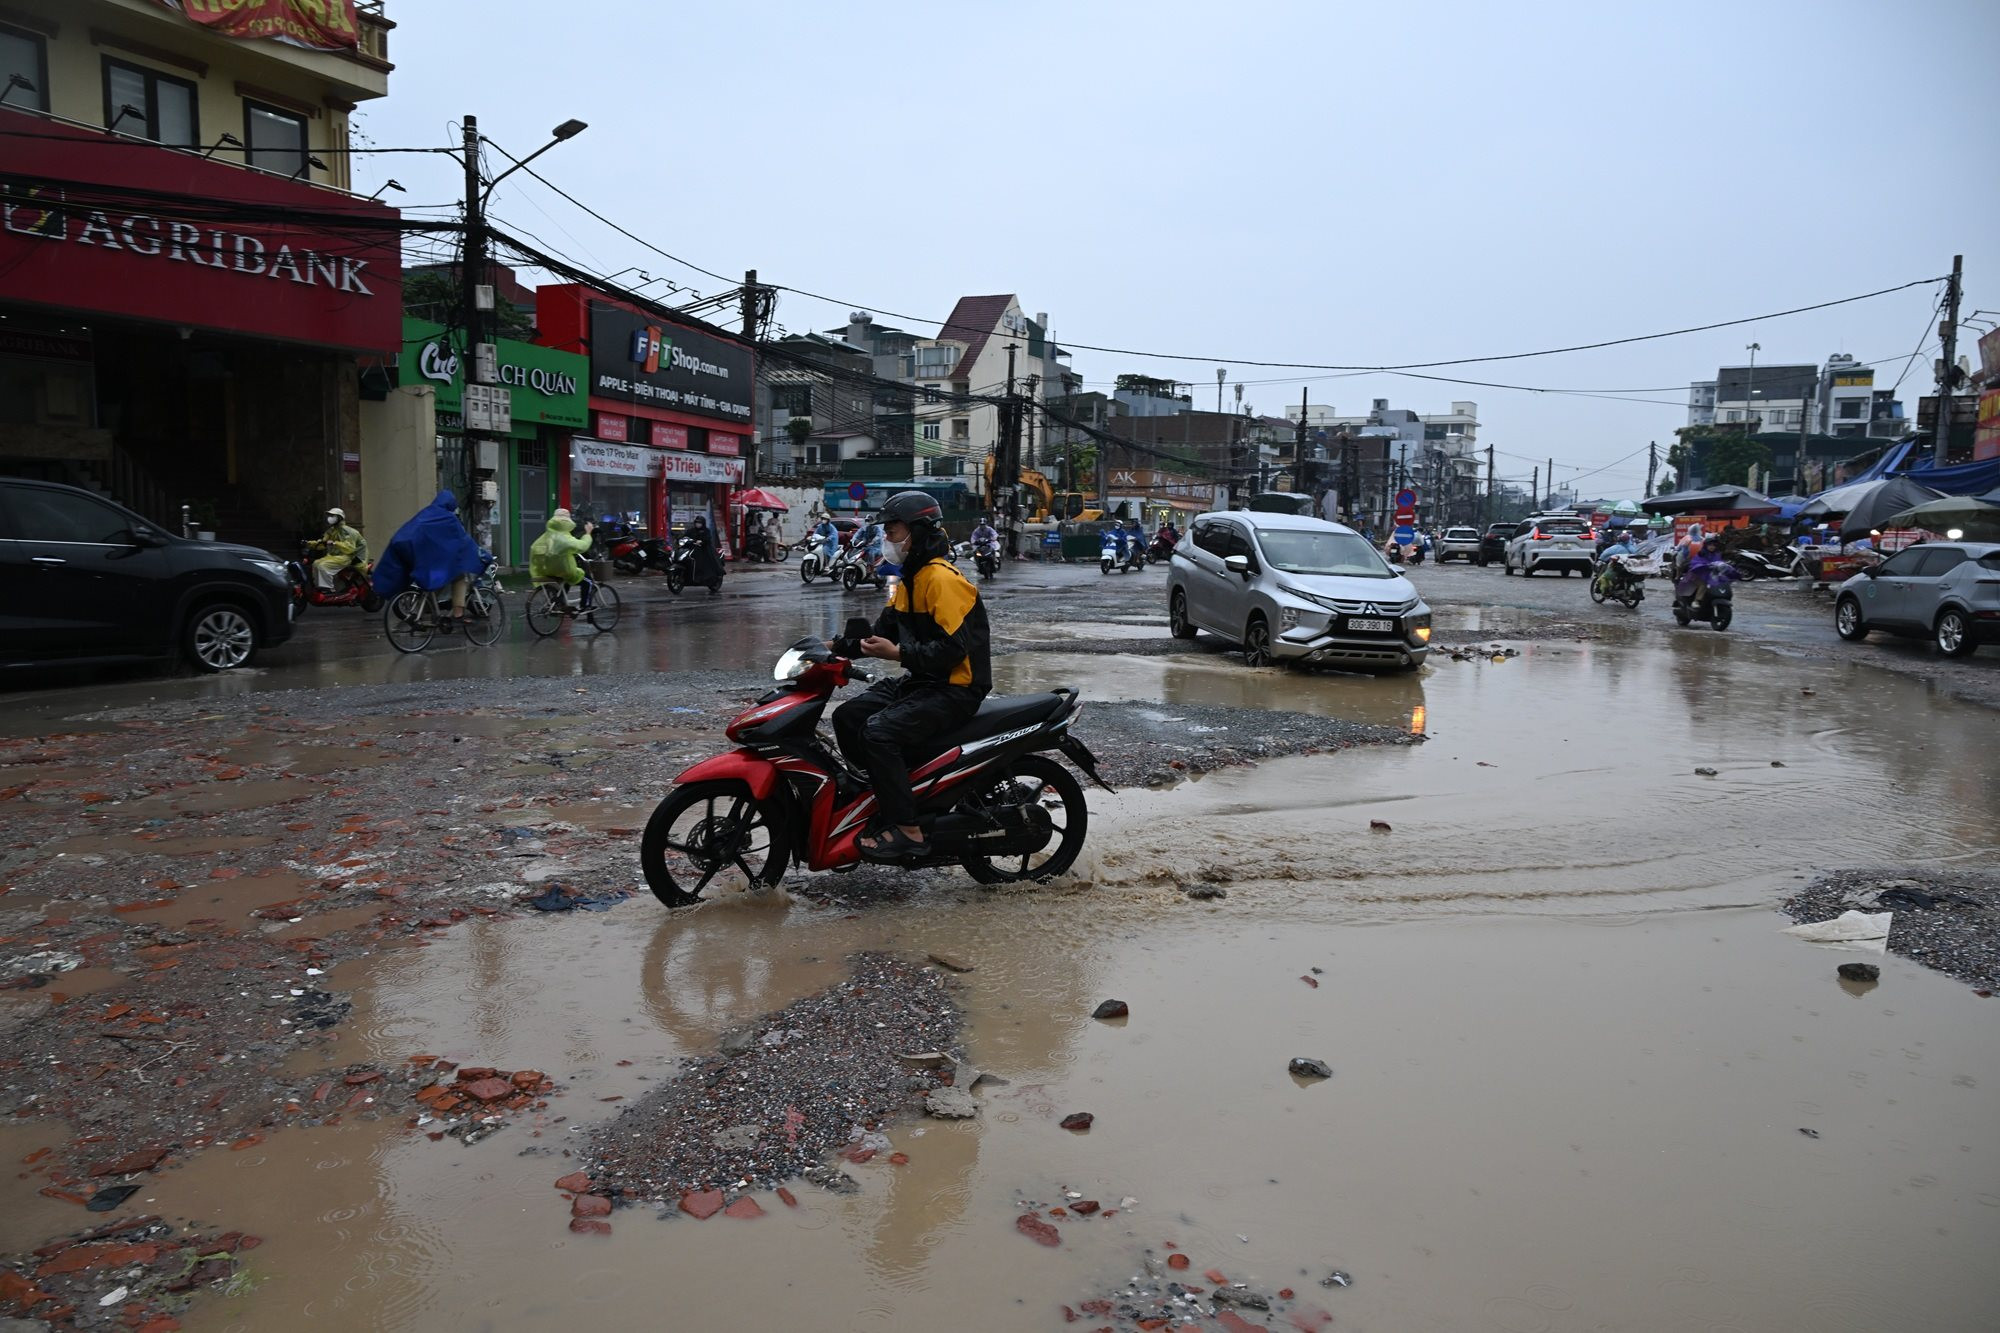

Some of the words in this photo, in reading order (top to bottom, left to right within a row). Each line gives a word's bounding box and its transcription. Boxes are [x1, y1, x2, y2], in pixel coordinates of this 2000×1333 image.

[78, 210, 374, 296] AGRIBANK
[531, 368, 576, 396] QUÁN
[599, 375, 628, 392] APPLE
[634, 381, 654, 400] ĐIỆN
[655, 387, 679, 405] THOẠI
[720, 401, 732, 412] GIA
[732, 404, 751, 418] DỤNG
[581, 444, 605, 457] iPhone
[606, 447, 614, 457] 17
[615, 449, 626, 459] Pro
[675, 456, 701, 477] Triệu
[1110, 471, 1137, 484] AK
